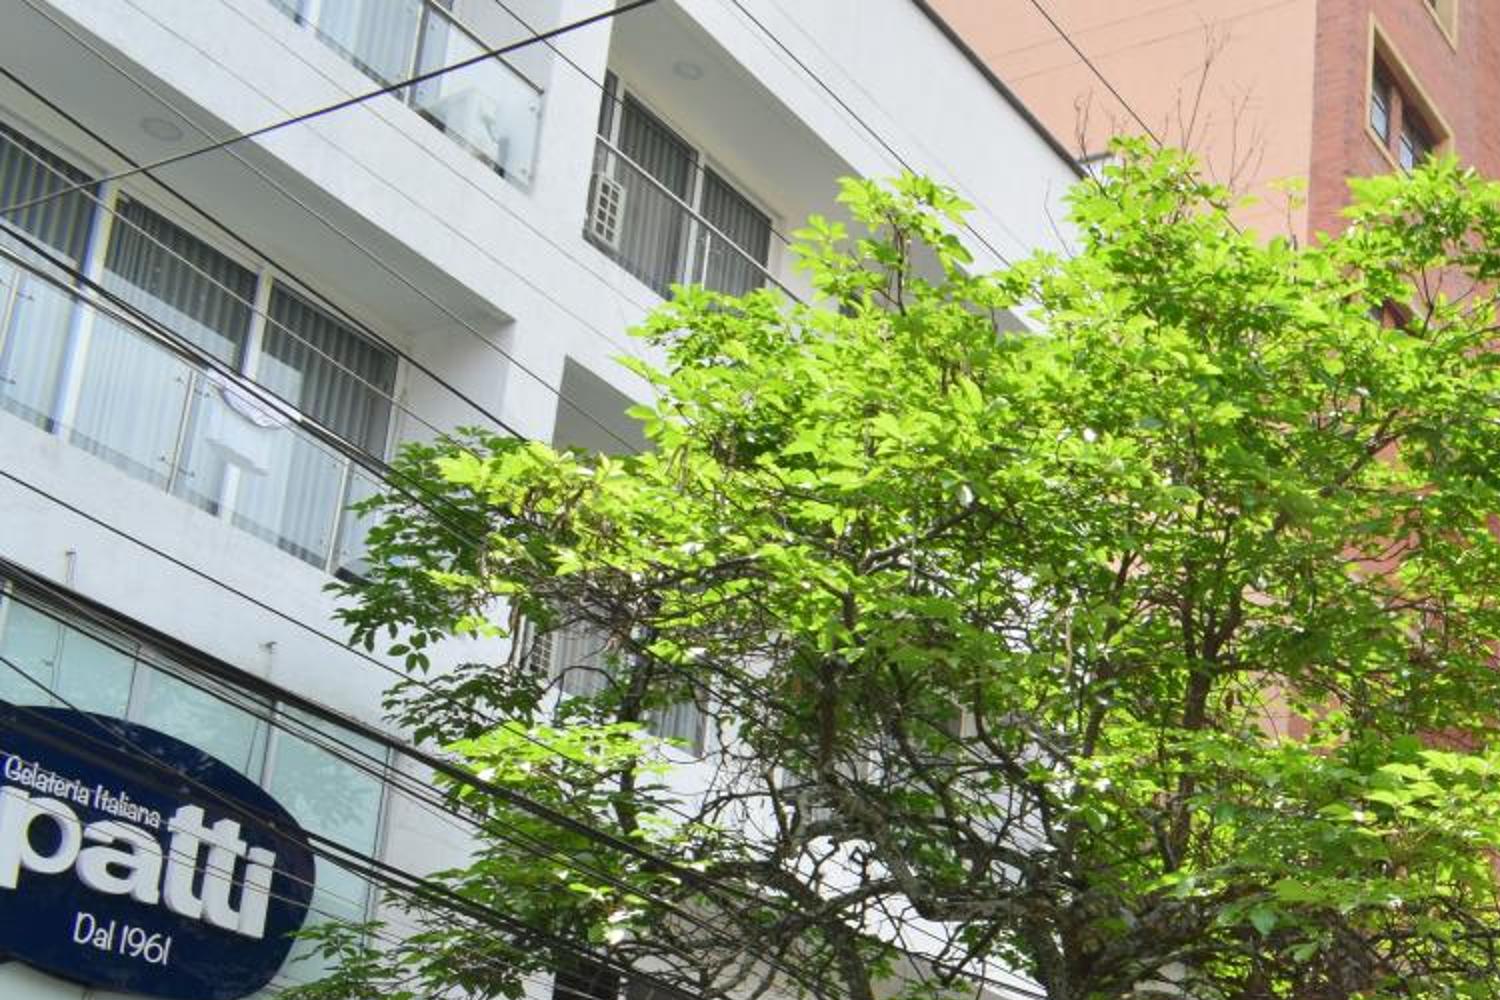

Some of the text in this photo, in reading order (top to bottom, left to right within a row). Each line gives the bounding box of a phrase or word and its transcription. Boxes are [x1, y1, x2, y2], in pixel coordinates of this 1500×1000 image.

[4, 755, 161, 830] Gelateria Italiana
[0, 785, 277, 939] patti
[73, 912, 172, 966] Dal 1961
